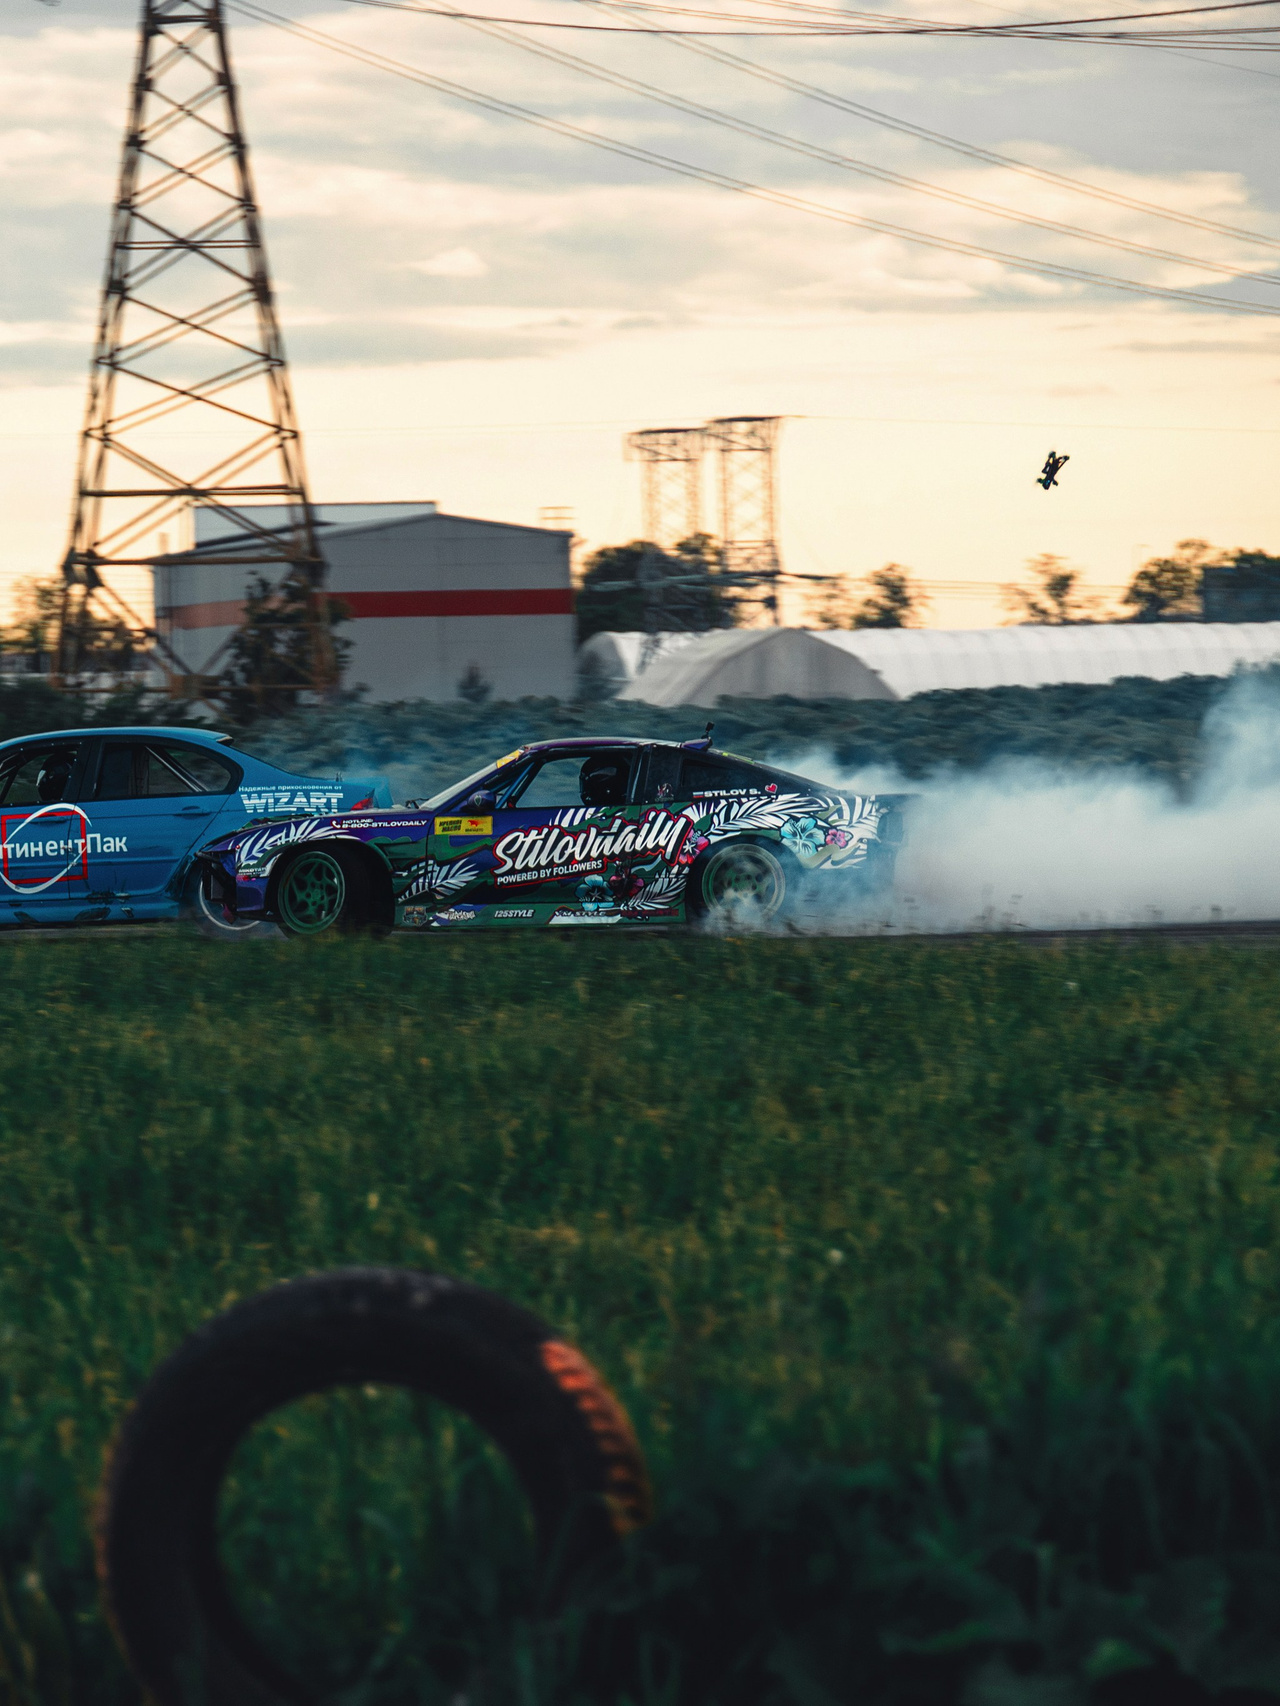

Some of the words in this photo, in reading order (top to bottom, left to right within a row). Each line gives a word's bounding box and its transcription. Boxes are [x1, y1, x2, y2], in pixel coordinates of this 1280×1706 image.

[704, 789, 746, 797] STILOV
[241, 792, 343, 813] WIZART
[497, 867, 538, 885] POWERED
[540, 866, 552, 877] BY
[553, 859, 603, 876] FOLLOWERS
[494, 909, 534, 918] 125STYLE
